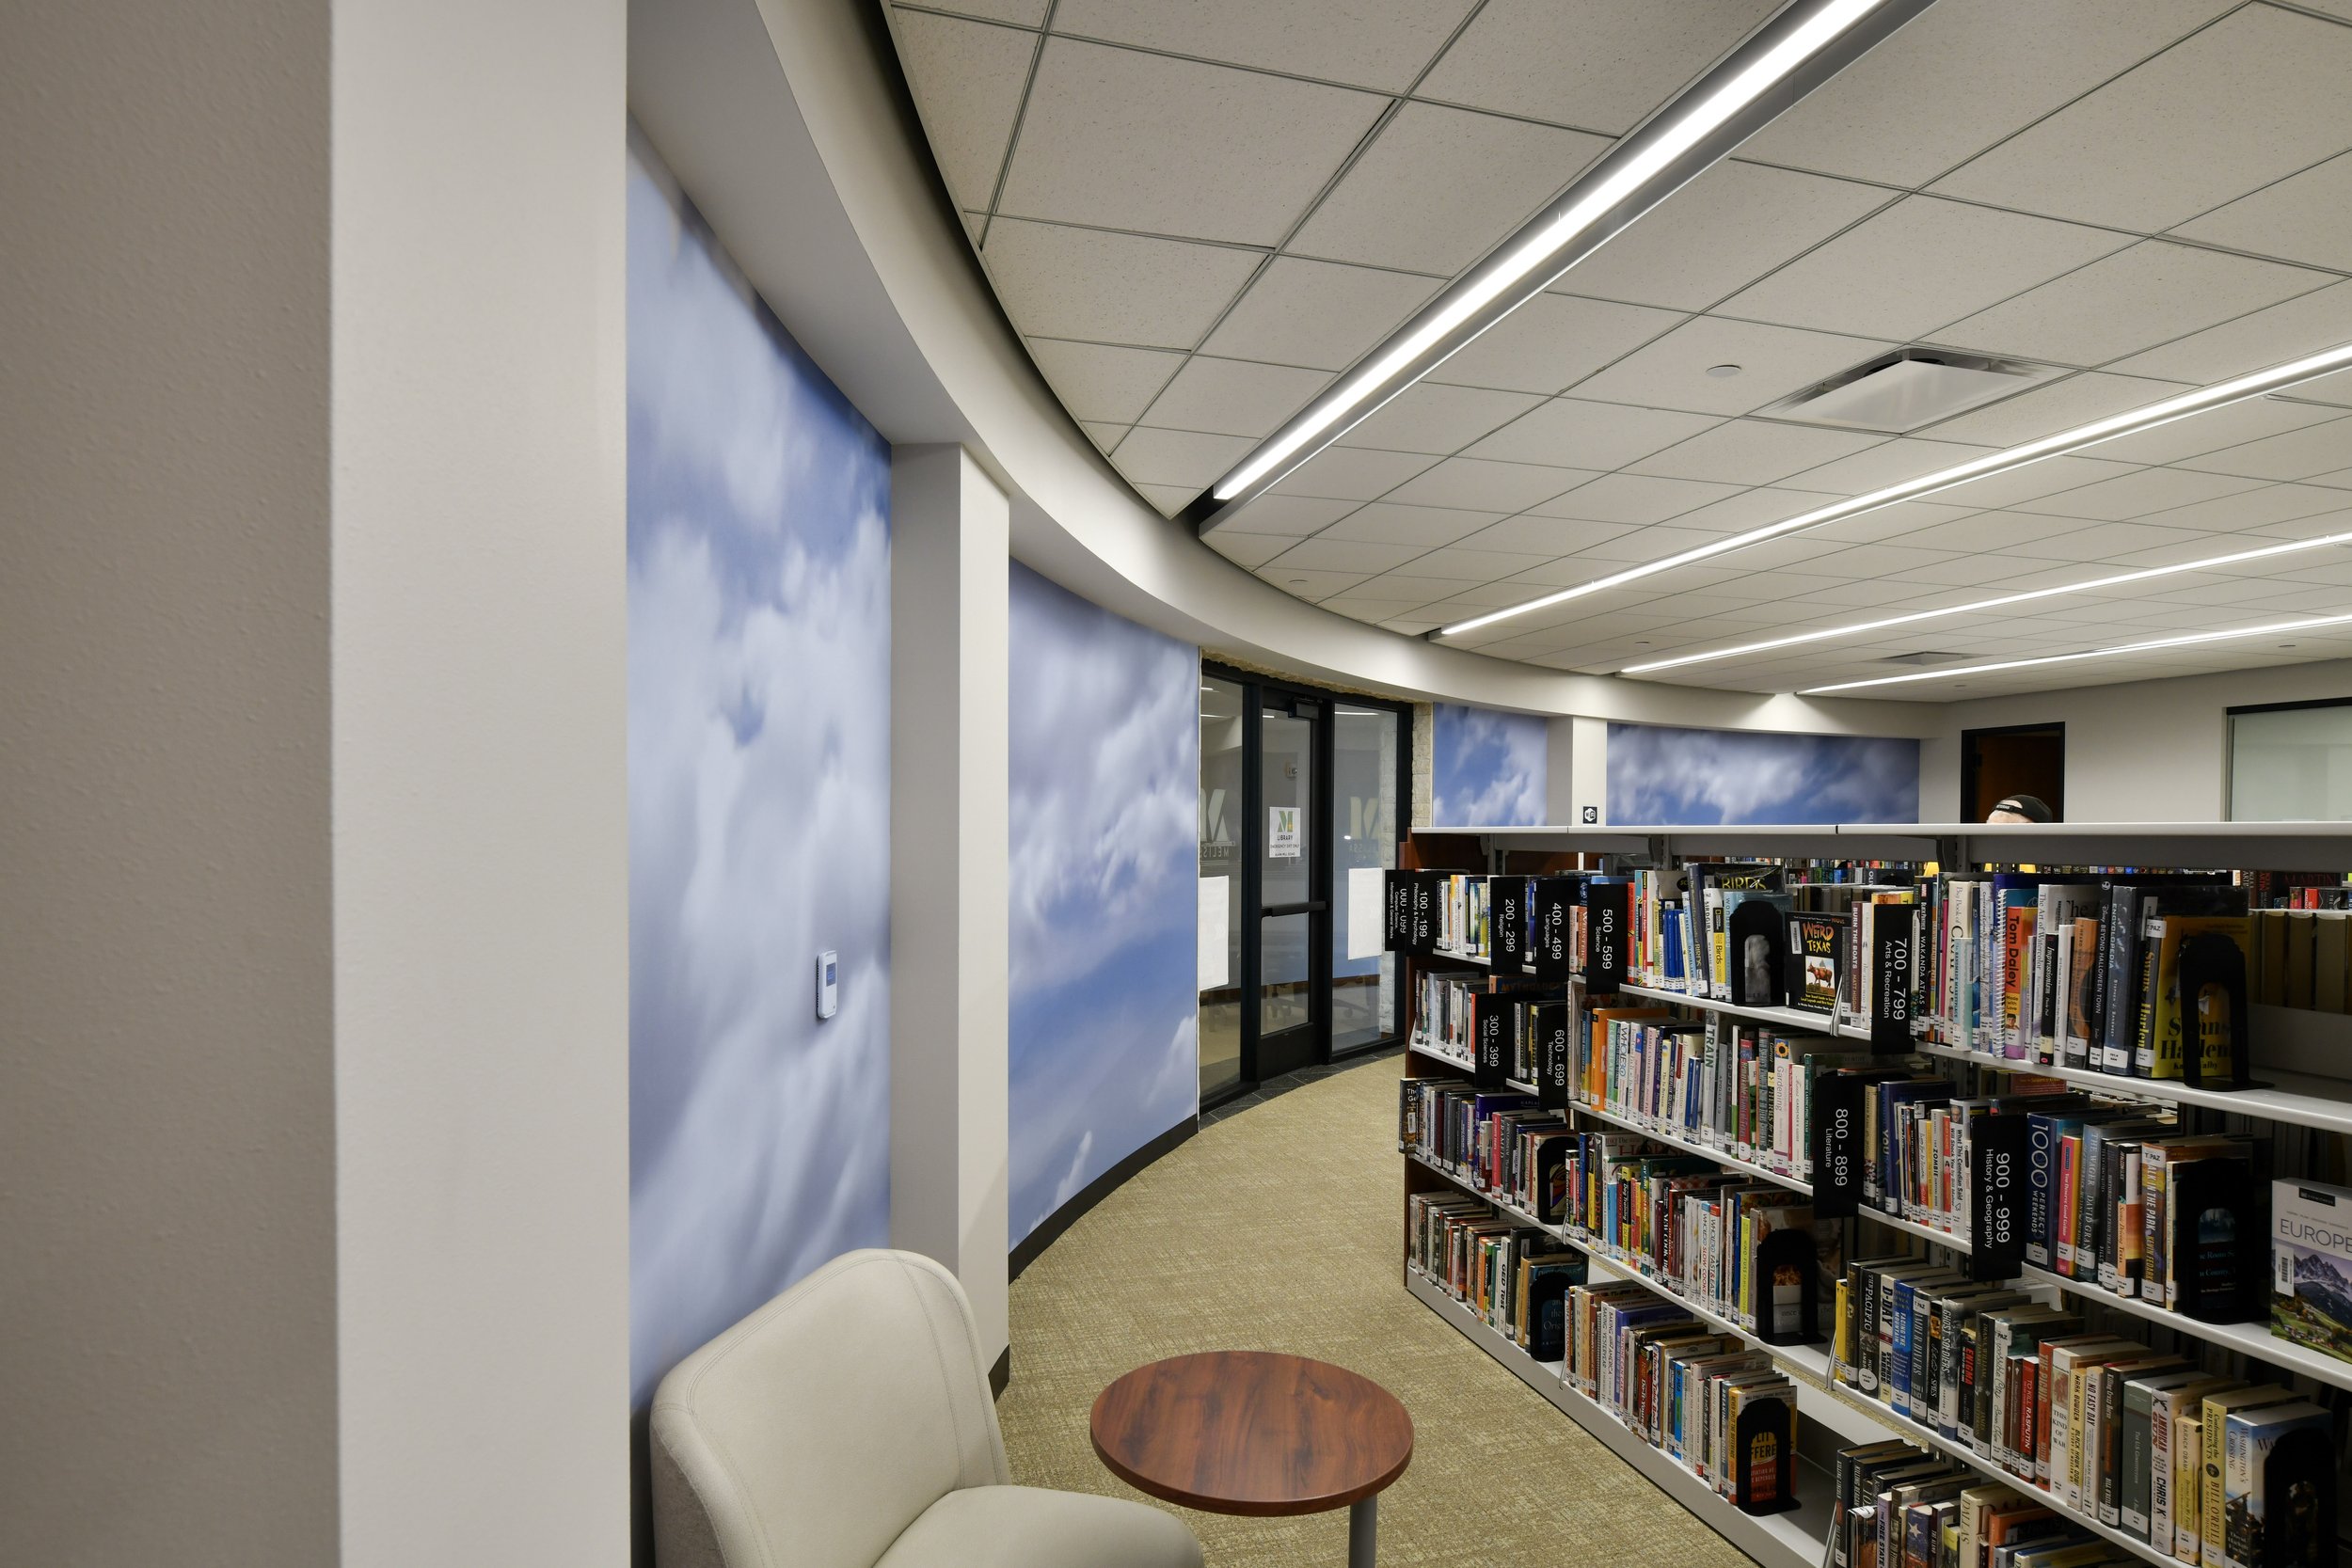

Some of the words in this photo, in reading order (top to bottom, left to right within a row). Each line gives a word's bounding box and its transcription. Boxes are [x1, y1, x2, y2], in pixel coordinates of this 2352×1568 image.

[1419, 891, 1428, 910] 100
[1505, 898, 1515, 920] 200
[1551, 903, 1562, 926] 400
[1419, 918, 1428, 937] 199
[1602, 909, 1613, 933] 500
[2009, 916, 2019, 944] Tom
[1505, 931, 1515, 952] 299
[1551, 937, 1562, 959] 499
[1807, 940, 1832, 954] TEXAS
[2108, 903, 2117, 969] ENCYCLOPEDIA
[1602, 945, 1613, 970] 599
[1894, 938, 1907, 971] 700
[2007, 948, 2019, 988] Daley
[2044, 946, 2055, 994] Impressionism
[2096, 953, 2105, 993] HALLOWEEN
[1893, 988, 1906, 1021] 799
[1489, 1015, 1499, 1035] 300
[1555, 1029, 1565, 1053] 600
[1706, 1029, 1715, 1069] TRAIN
[1489, 1046, 1499, 1067] 399
[1555, 1064, 1565, 1086] 699
[1775, 1066, 1785, 1111] Gardening
[1836, 1108, 1849, 1139] 800
[1985, 1148, 1994, 1182] History
[1995, 1152, 2010, 1188] 900
[2031, 1124, 2049, 1188] 1000
[2088, 1154, 2097, 1186] WAGER
[1835, 1155, 1848, 1186] 899
[2146, 1193, 2155, 1207] THE
[2147, 1182, 2155, 1192] IN
[1984, 1196, 1994, 1248] Geography
[2085, 1195, 2093, 1223] DAVID
[2145, 1209, 2155, 1230] PARK
[1995, 1208, 2010, 1243] 999
[1864, 1288, 1874, 1333] PACIFIC
[1882, 1286, 1892, 1326] D-DAY
[1942, 1310, 1950, 1335] GHOST
[1965, 1347, 1974, 1386] ENIGMA
[2040, 1354, 2048, 1370] THE
[2026, 1379, 2032, 1388] TO
[2039, 1371, 2047, 1402] PICNIC
[2088, 1384, 2096, 1393] NO
[2088, 1395, 2096, 1411] EASY
[2087, 1413, 2095, 1426] DAY
[2158, 1414, 2167, 1452] AMERICAN
[2229, 1431, 2237, 1470] CROSSING
[2239, 1427, 2249, 1483] WASHINGTON'S
[2156, 1477, 2166, 1505] CHRIS
[2211, 1481, 2219, 1504] BILL
[1962, 1499, 1970, 1544] DALLAS
